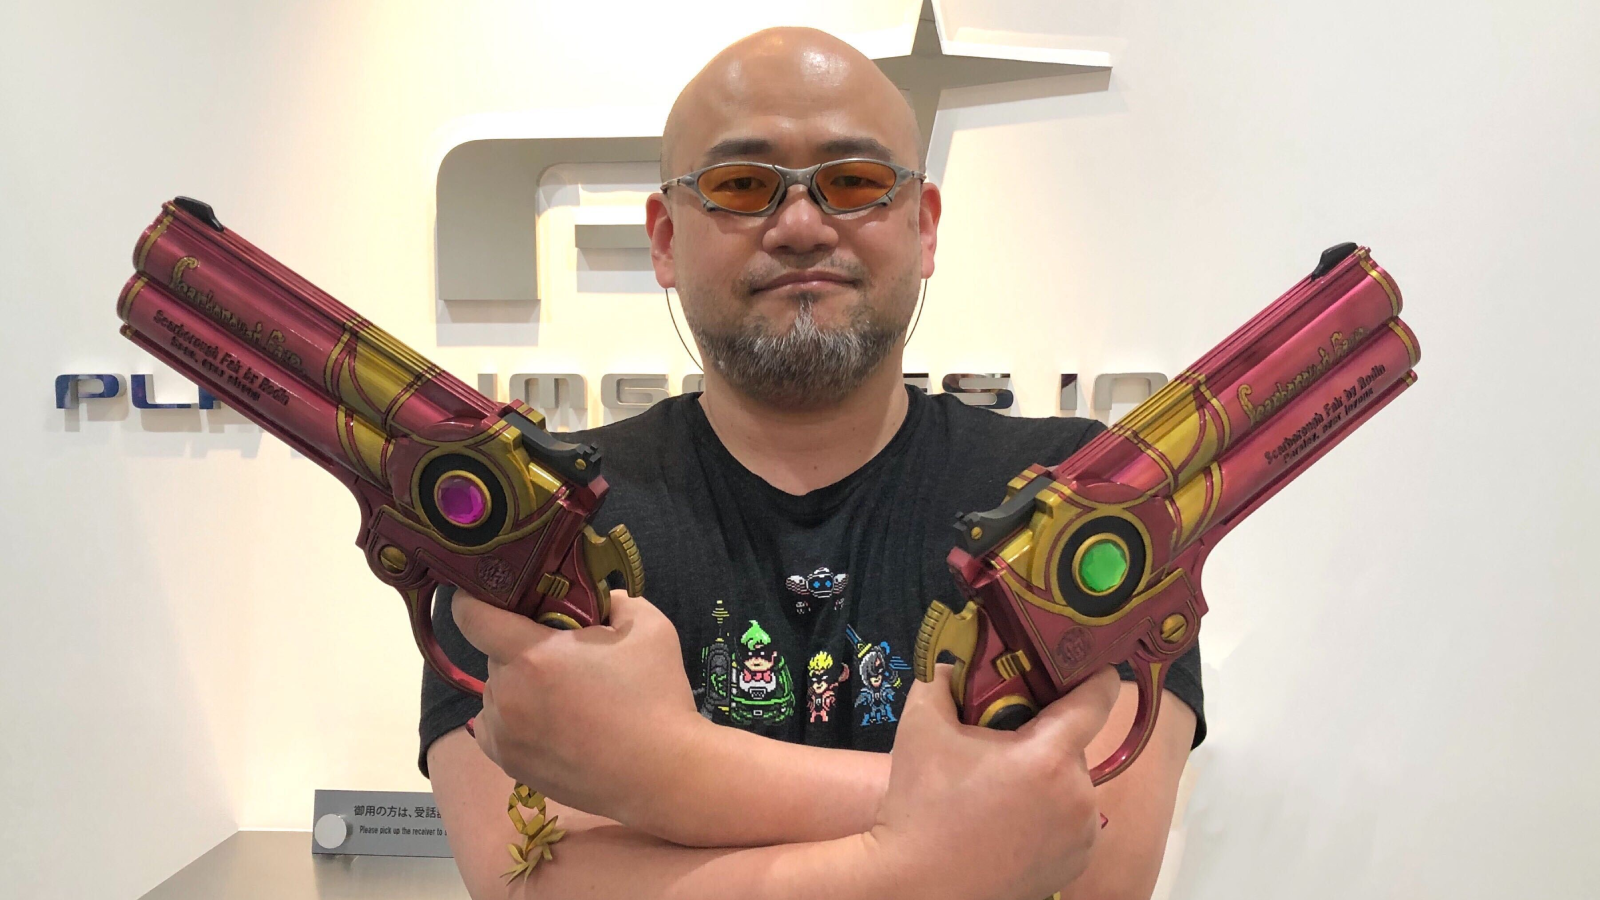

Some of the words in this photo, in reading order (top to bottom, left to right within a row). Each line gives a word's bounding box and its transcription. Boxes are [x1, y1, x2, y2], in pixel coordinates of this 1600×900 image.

[153, 310, 219, 362] Scarborough
[220, 352, 242, 374] Fair
[243, 367, 258, 384] by
[258, 376, 290, 406] Rodin
[1264, 412, 1324, 465] Scarborough
[1323, 396, 1345, 418] Fair
[1344, 388, 1357, 402] by
[1357, 364, 1386, 390] Rodin
[360, 825, 378, 835] Please
[380, 826, 391, 836] pick
[393, 828, 400, 836] up
[401, 826, 411, 836] the
[412, 827, 435, 836] receiver
[437, 827, 443, 836] to
